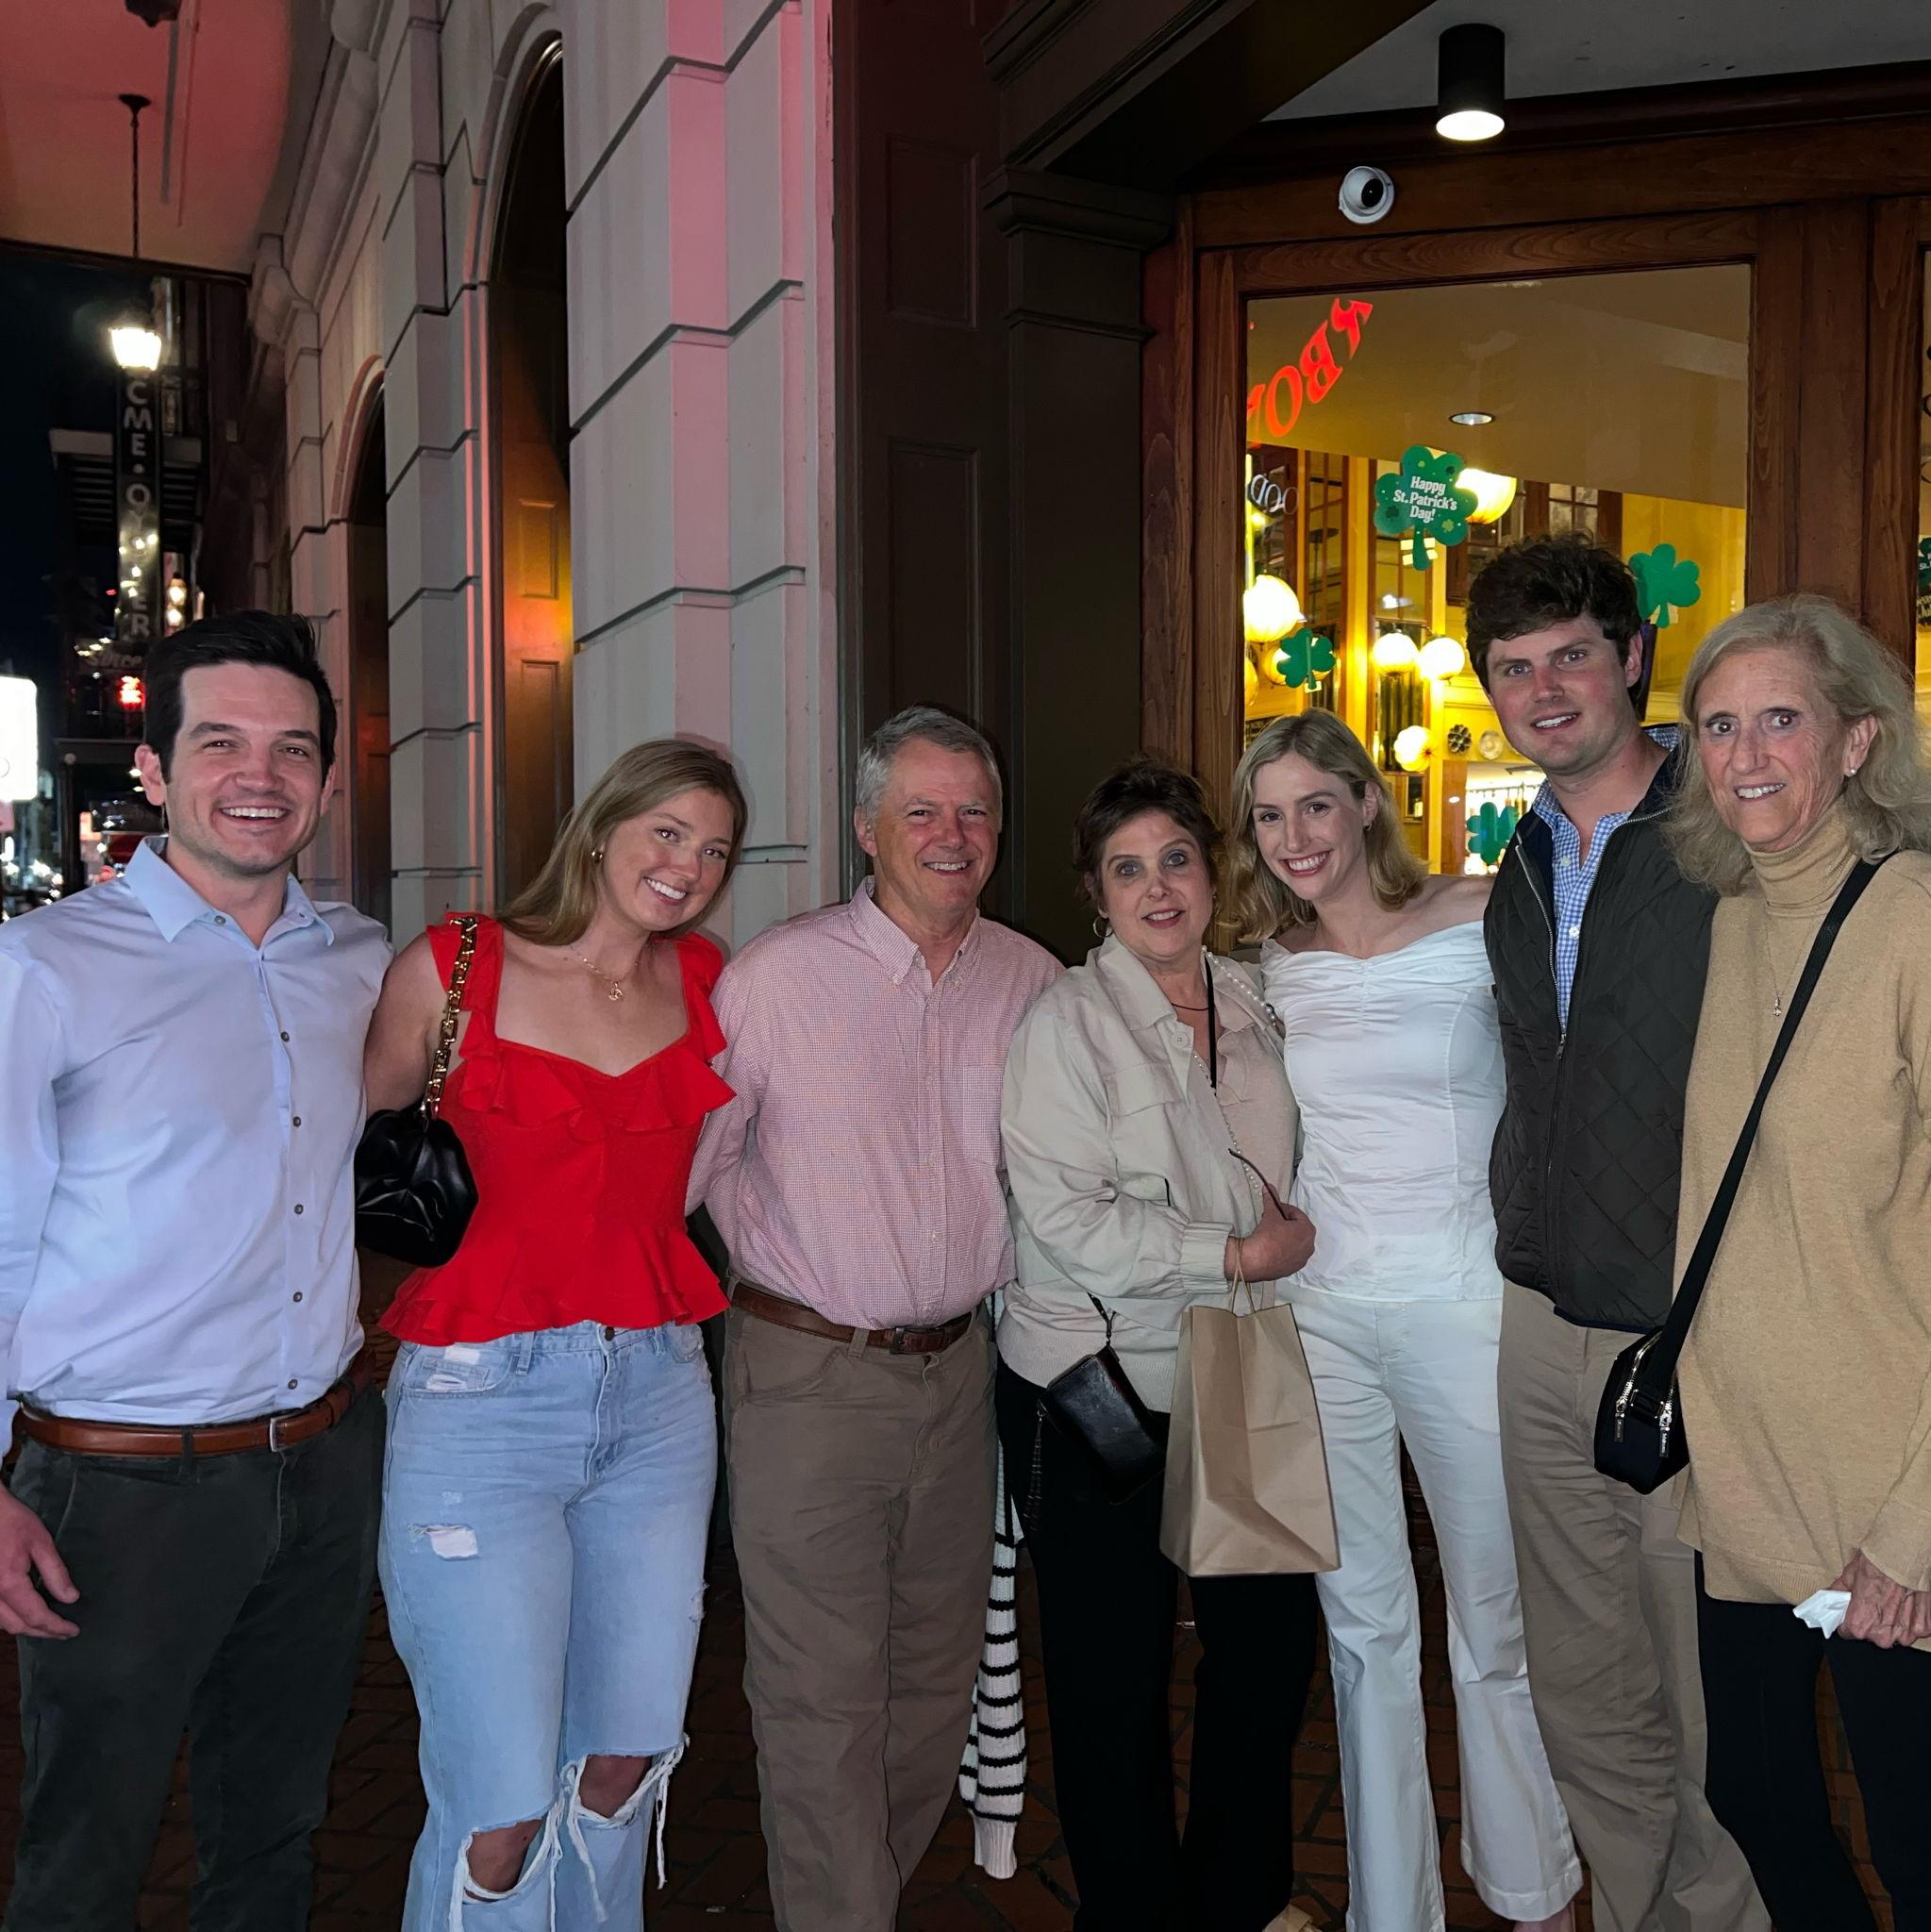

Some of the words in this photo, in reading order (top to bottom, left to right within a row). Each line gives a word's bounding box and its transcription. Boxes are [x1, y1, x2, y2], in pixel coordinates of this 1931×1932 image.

[124, 372, 153, 457] CME
[1410, 475, 1446, 496] Happy
[1392, 489, 1408, 504] St.
[1408, 491, 1457, 510] Patrick's
[1409, 505, 1436, 524] Day!
